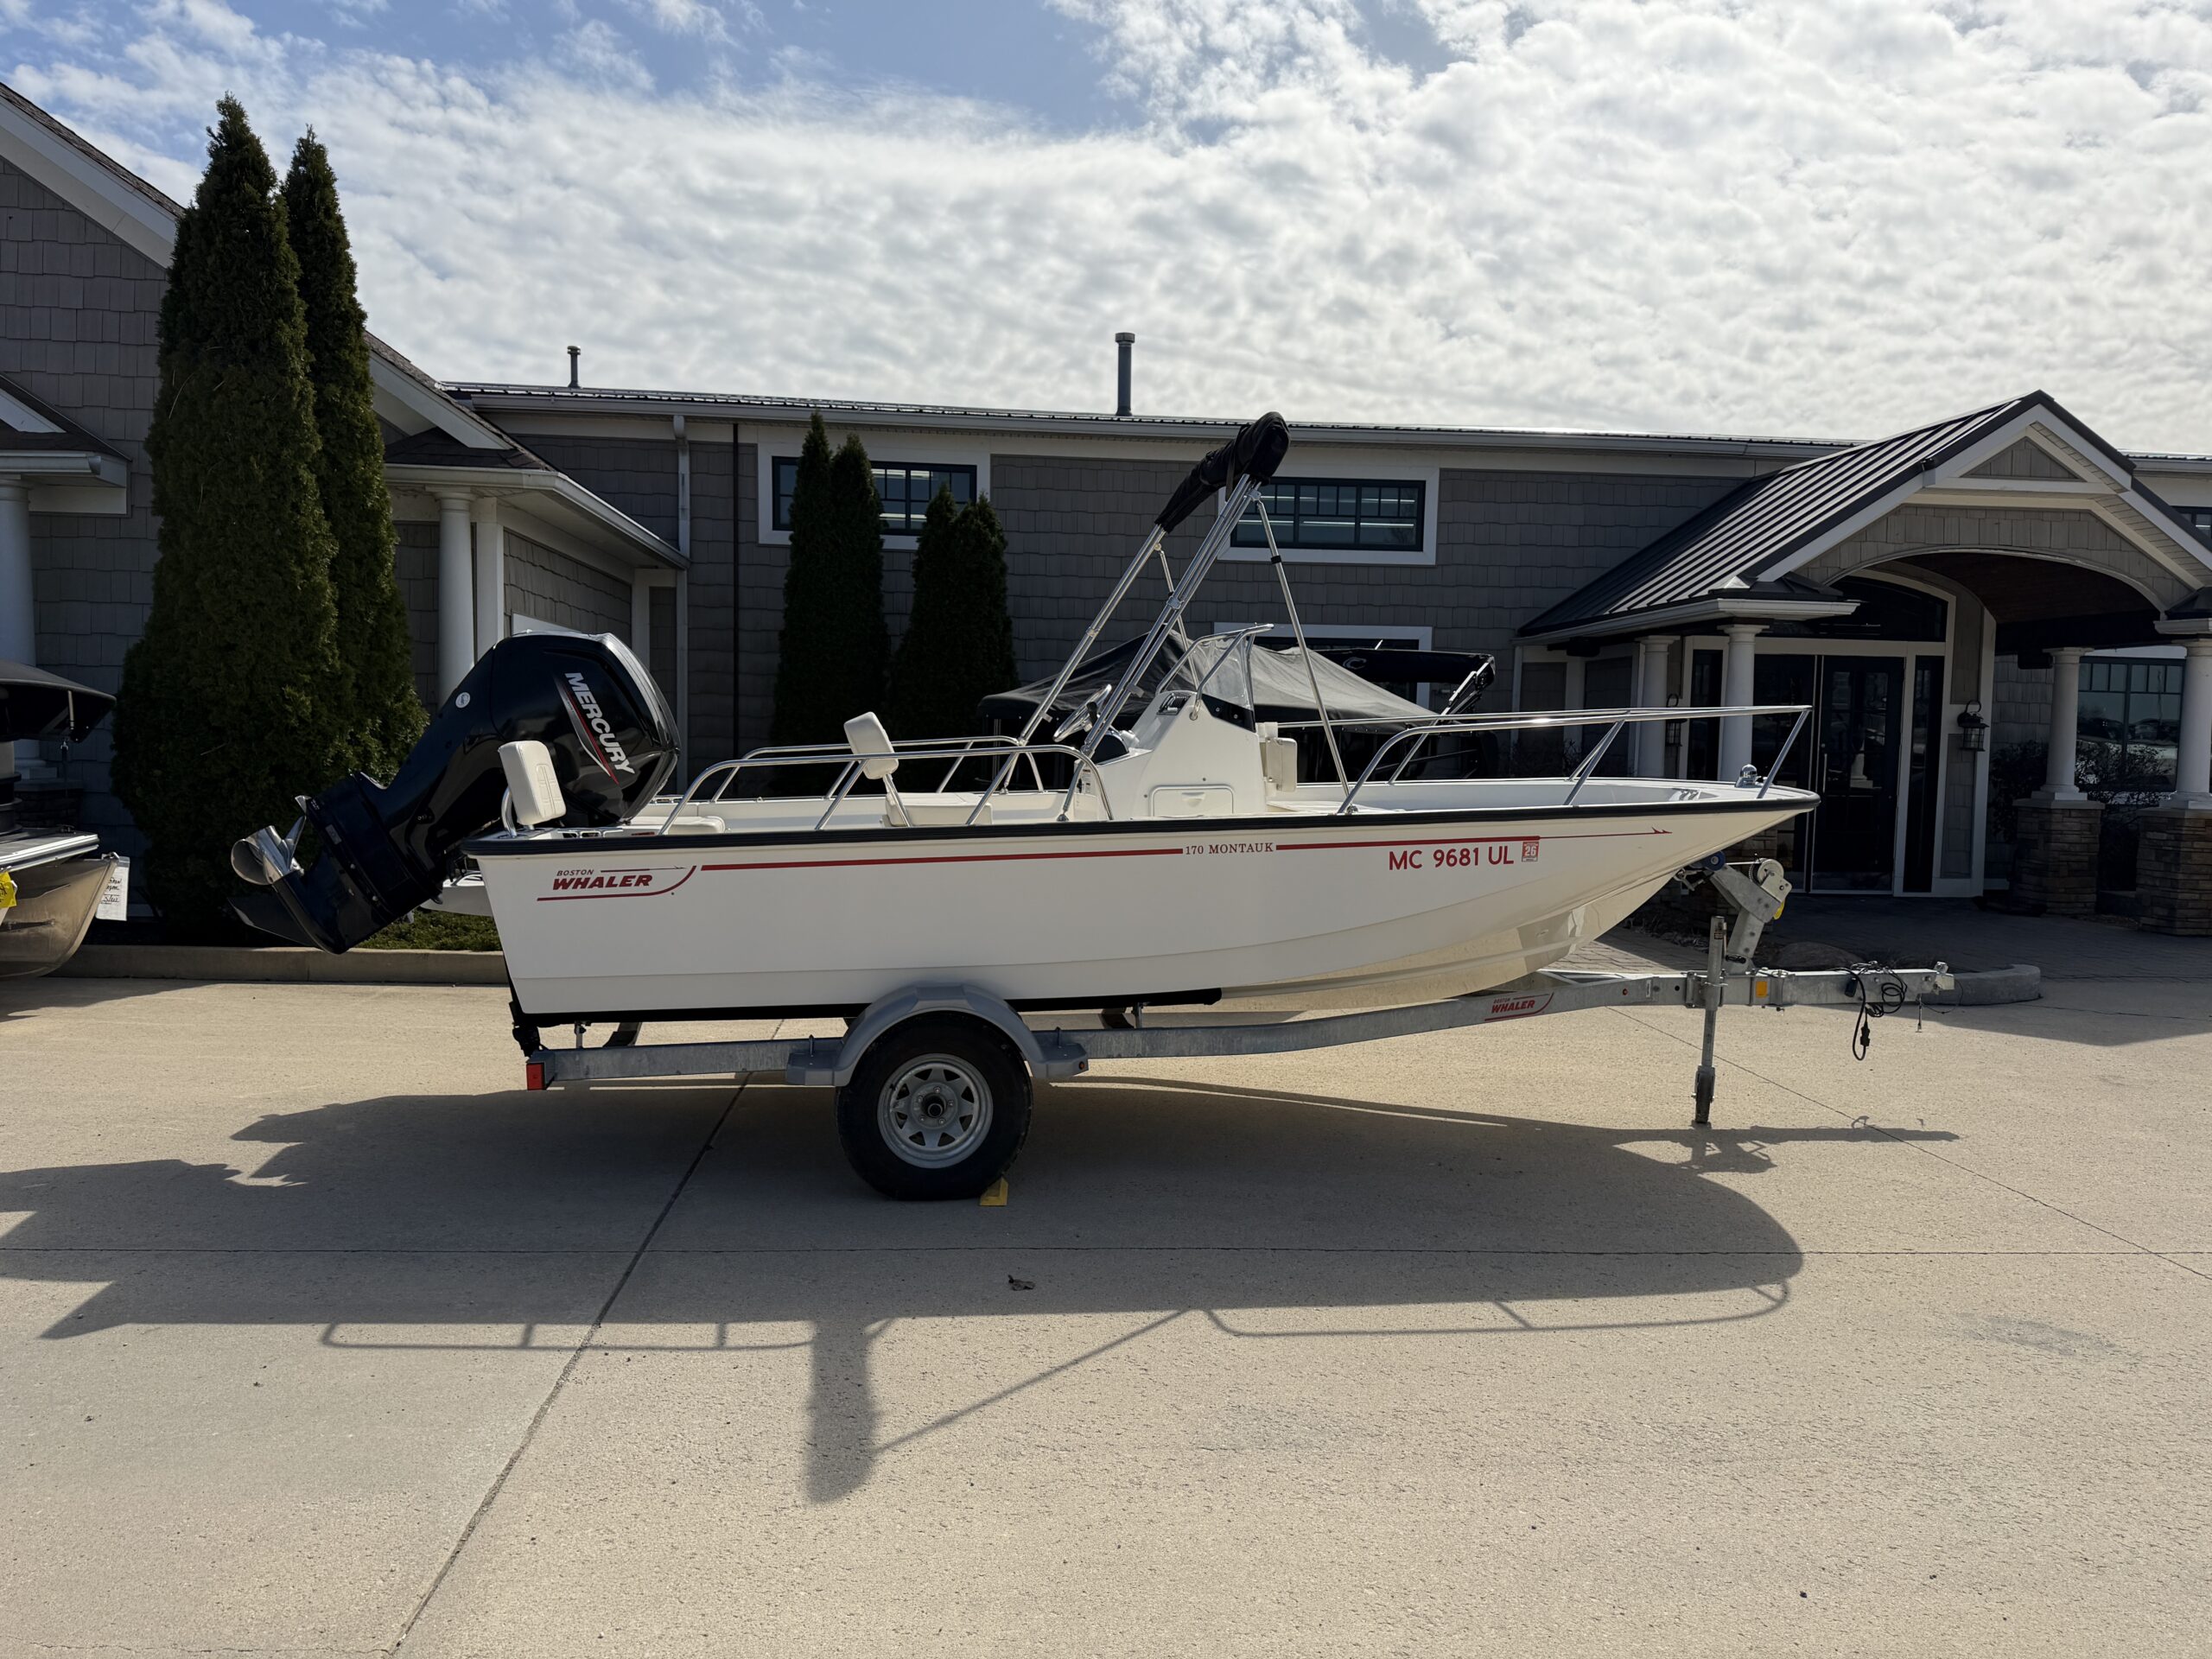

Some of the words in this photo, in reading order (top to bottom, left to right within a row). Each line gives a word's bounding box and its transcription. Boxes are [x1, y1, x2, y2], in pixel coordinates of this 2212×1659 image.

[564, 672, 635, 774] MERCURY
[1185, 845, 1205, 855] 170
[1209, 842, 1274, 855] MONTAUK
[1524, 845, 1537, 856] 26
[1389, 850, 1422, 870] MC
[1433, 848, 1479, 868] 9681
[1488, 845, 1515, 865] UL
[552, 874, 653, 891] WHALER
[1491, 1000, 1535, 1014] WHALER
